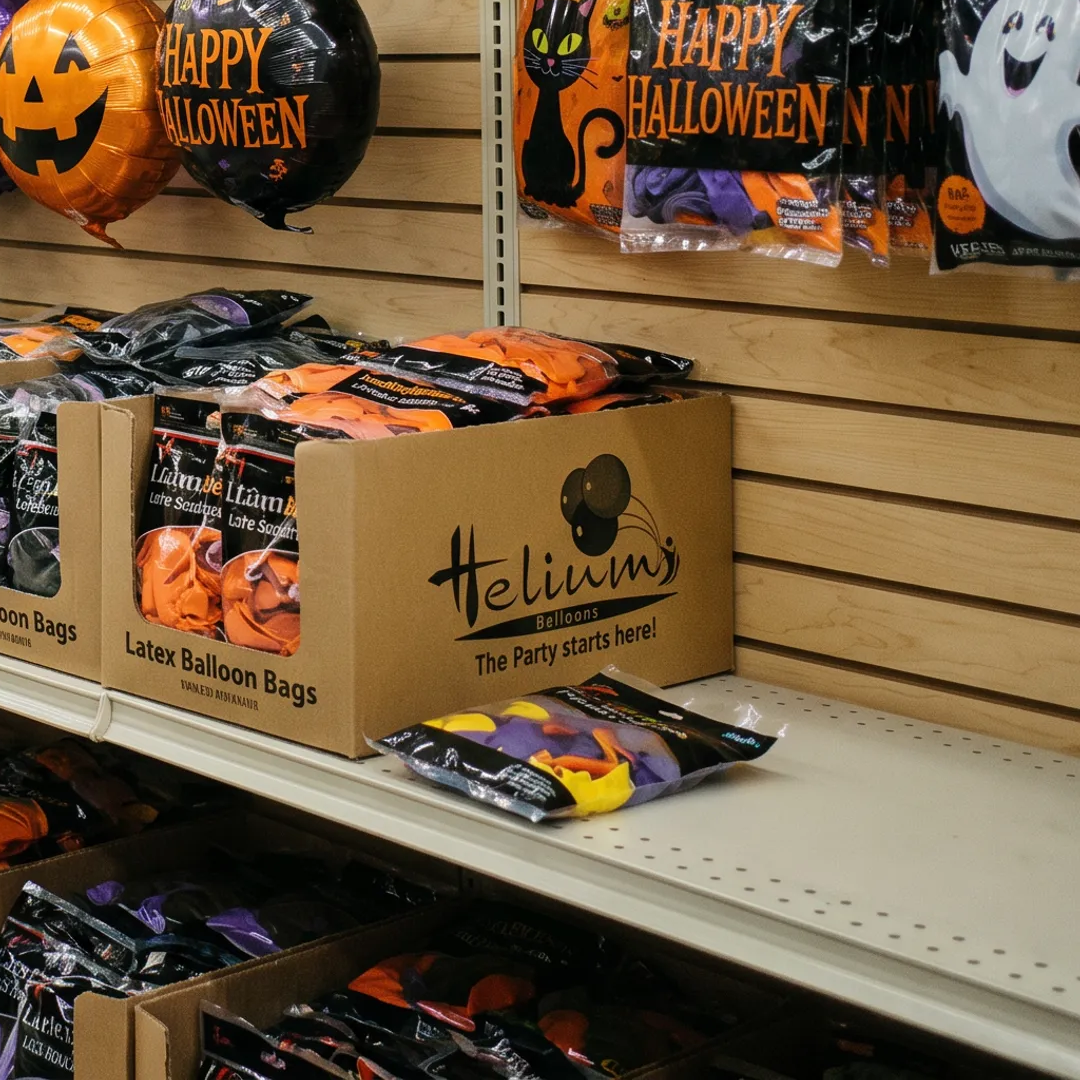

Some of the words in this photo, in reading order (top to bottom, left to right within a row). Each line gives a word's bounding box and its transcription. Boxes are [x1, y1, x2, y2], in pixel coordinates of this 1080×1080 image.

[162, 23, 274, 94] HAPPY
[652, 0, 805, 78] HAPPY
[627, 75, 834, 147] HALLOWEEN
[33, 610, 78, 645] Bags
[475, 652, 508, 676] The
[513, 643, 558, 667] Party
[562, 630, 610, 657] starts
[615, 616, 656, 646] here!
[125, 630, 177, 668] Latex
[181, 647, 258, 690] Balloon
[264, 668, 318, 708] Bags
